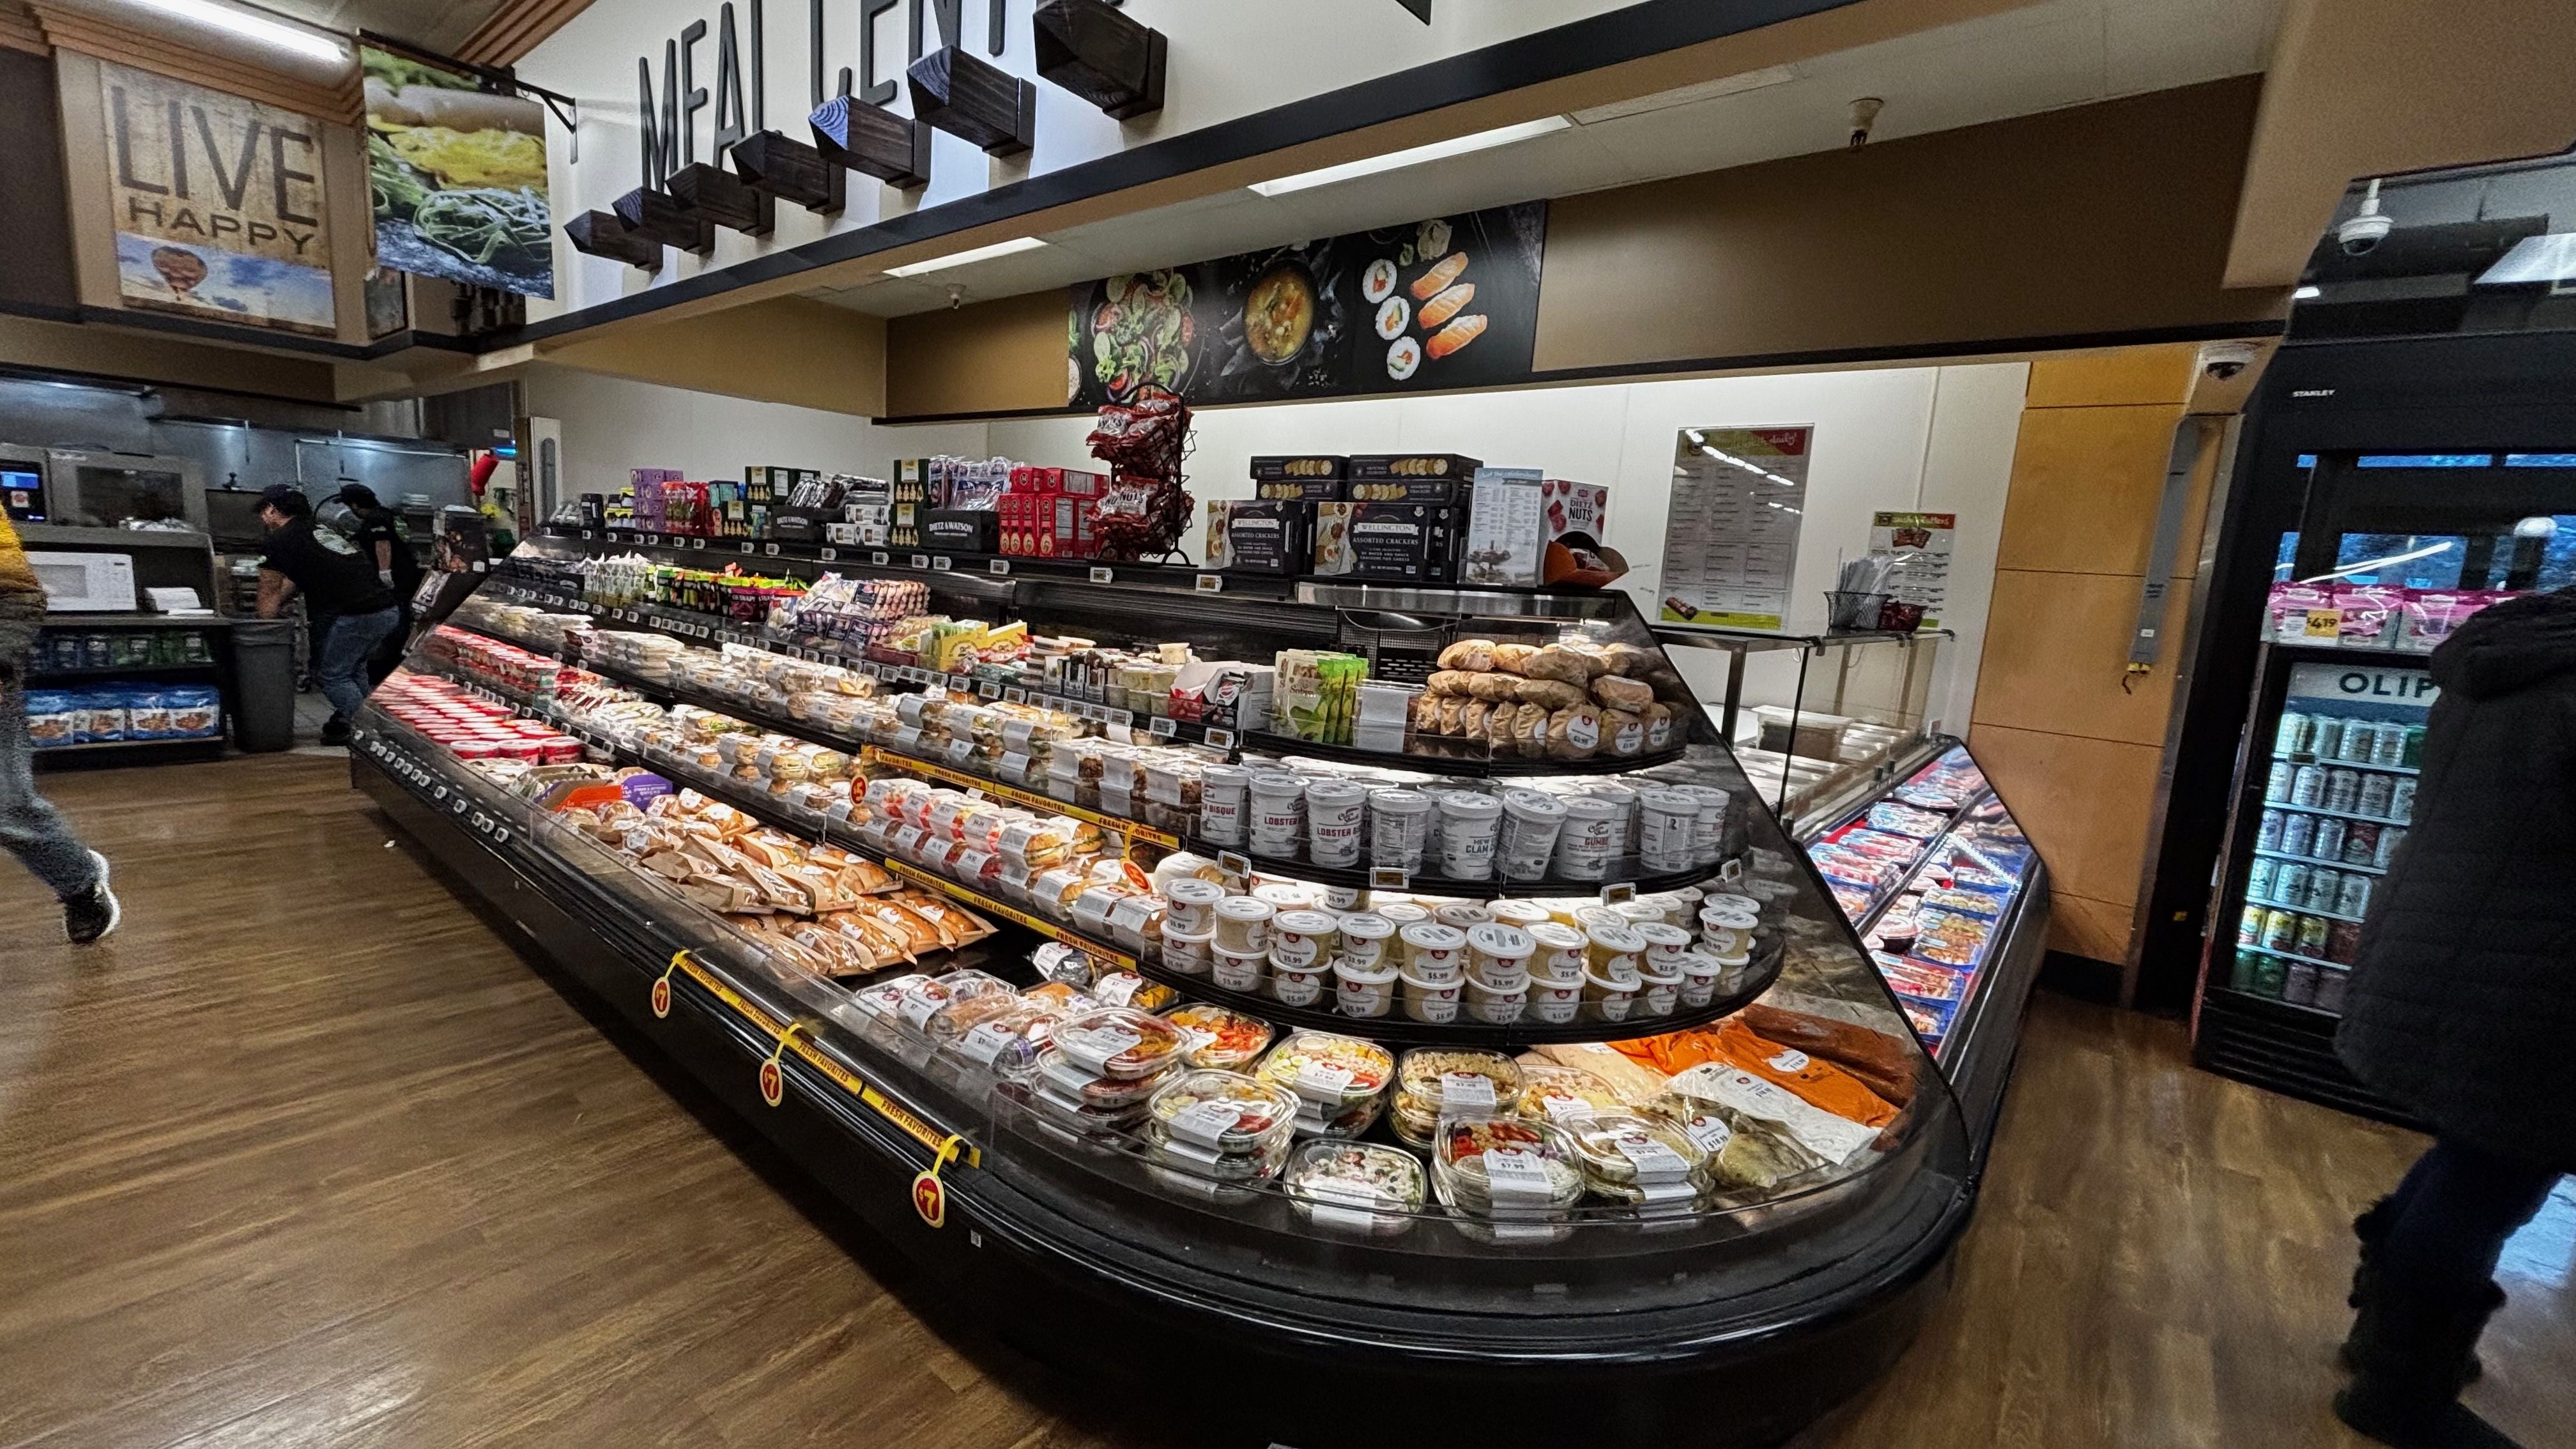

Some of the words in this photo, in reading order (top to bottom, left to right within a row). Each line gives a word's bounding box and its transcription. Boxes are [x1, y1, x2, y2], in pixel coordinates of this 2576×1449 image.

[110, 86, 319, 227] LIVE
[129, 195, 314, 255] HAPPY
[2292, 389, 2336, 397] STANLEY
[1568, 507, 1593, 522] NUTS
[1570, 500, 1593, 509] DIETZ
[929, 521, 944, 532] DIETZ
[948, 521, 974, 533] WATSON
[2339, 672, 2436, 698] OLIP
[935, 769, 952, 779] FRESH
[952, 773, 982, 788] FAVORITES
[1011, 790, 1032, 803] FRESH
[1031, 795, 1066, 813] FAVORITES
[1209, 804, 1236, 815] BISQUE
[1099, 817, 1121, 830] FRESH
[1122, 824, 1162, 841] FORITES
[1264, 816, 1299, 825] LOBSTER
[1317, 827, 1351, 837] LOBSTER
[1466, 845, 1489, 854] CLAM
[899, 864, 917, 878] FRESH
[916, 872, 946, 890] FAVORITES
[973, 896, 993, 910] FRESH
[993, 904, 1027, 924] FAVORITES
[1328, 894, 1346, 903] $5.99
[1055, 931, 1078, 947] FRESH
[1078, 940, 1119, 962] FAVORITES
[1284, 954, 1302, 963] $5.99
[684, 960, 701, 975] FRESH
[700, 970, 722, 992] FAVORITES
[656, 988, 668, 1009] $7
[738, 999, 755, 1015] FRESH
[754, 1009, 781, 1035] FAVORITES
[797, 1041, 819, 1061] FRESH
[816, 1055, 850, 1082] FAVORITES
[763, 1073, 778, 1099] $7
[881, 1100, 907, 1124] FRESH
[903, 1113, 943, 1148] FAVORITES
[1708, 1134, 1729, 1149] $18.99
[917, 1184, 937, 1218] $7
